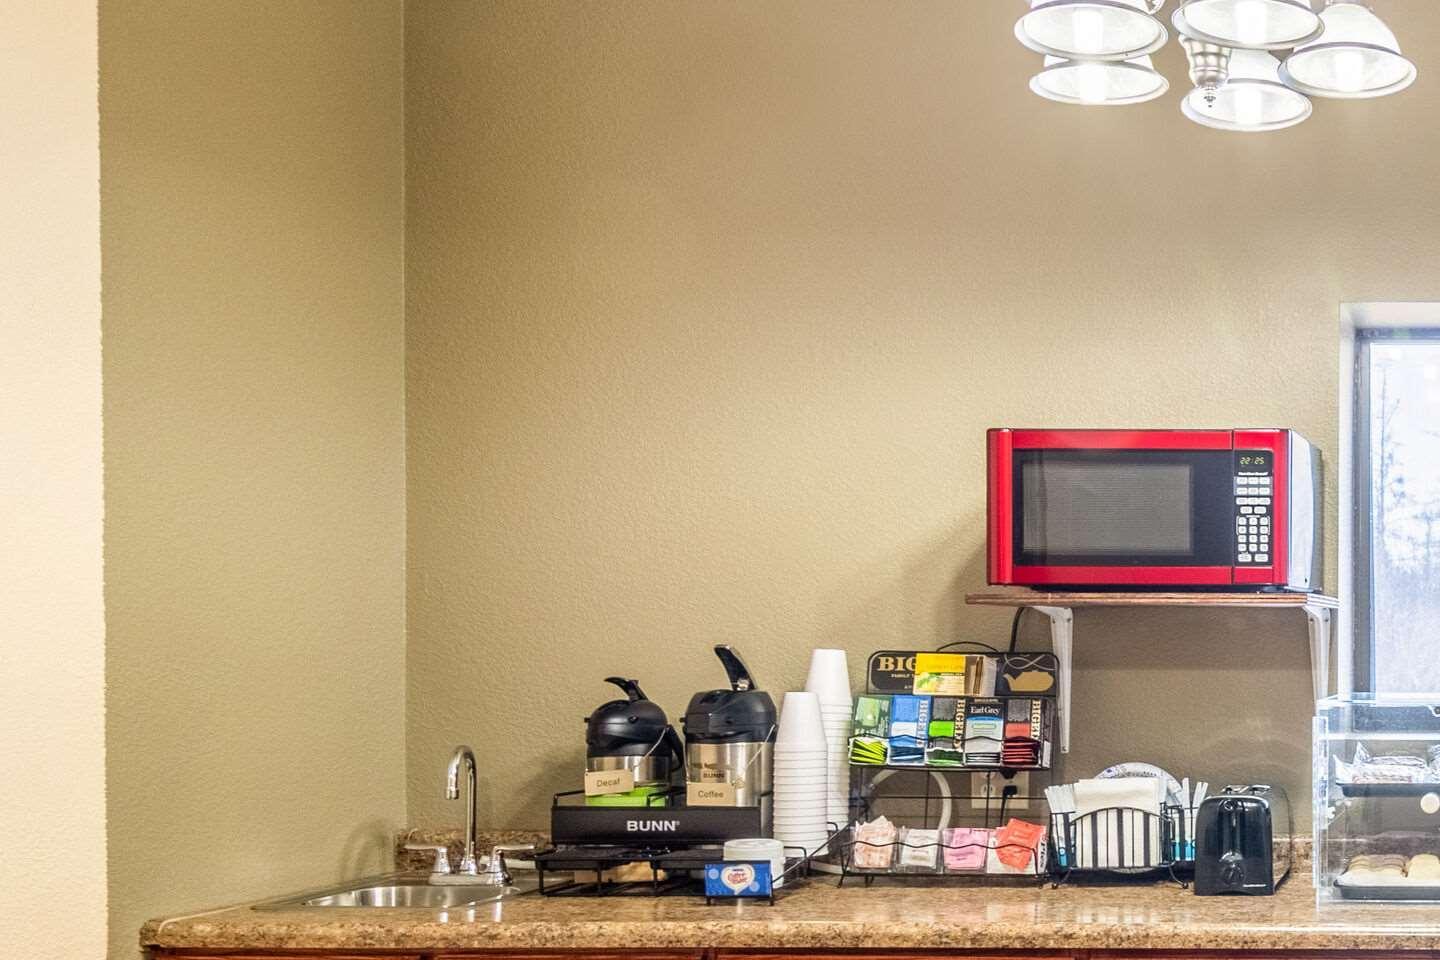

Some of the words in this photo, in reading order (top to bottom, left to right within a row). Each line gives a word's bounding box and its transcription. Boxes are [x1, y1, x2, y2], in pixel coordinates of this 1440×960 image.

[970, 706, 984, 714] Earl
[985, 706, 999, 715] Grey
[596, 778, 621, 787] Decaf
[697, 790, 724, 798] Coffee
